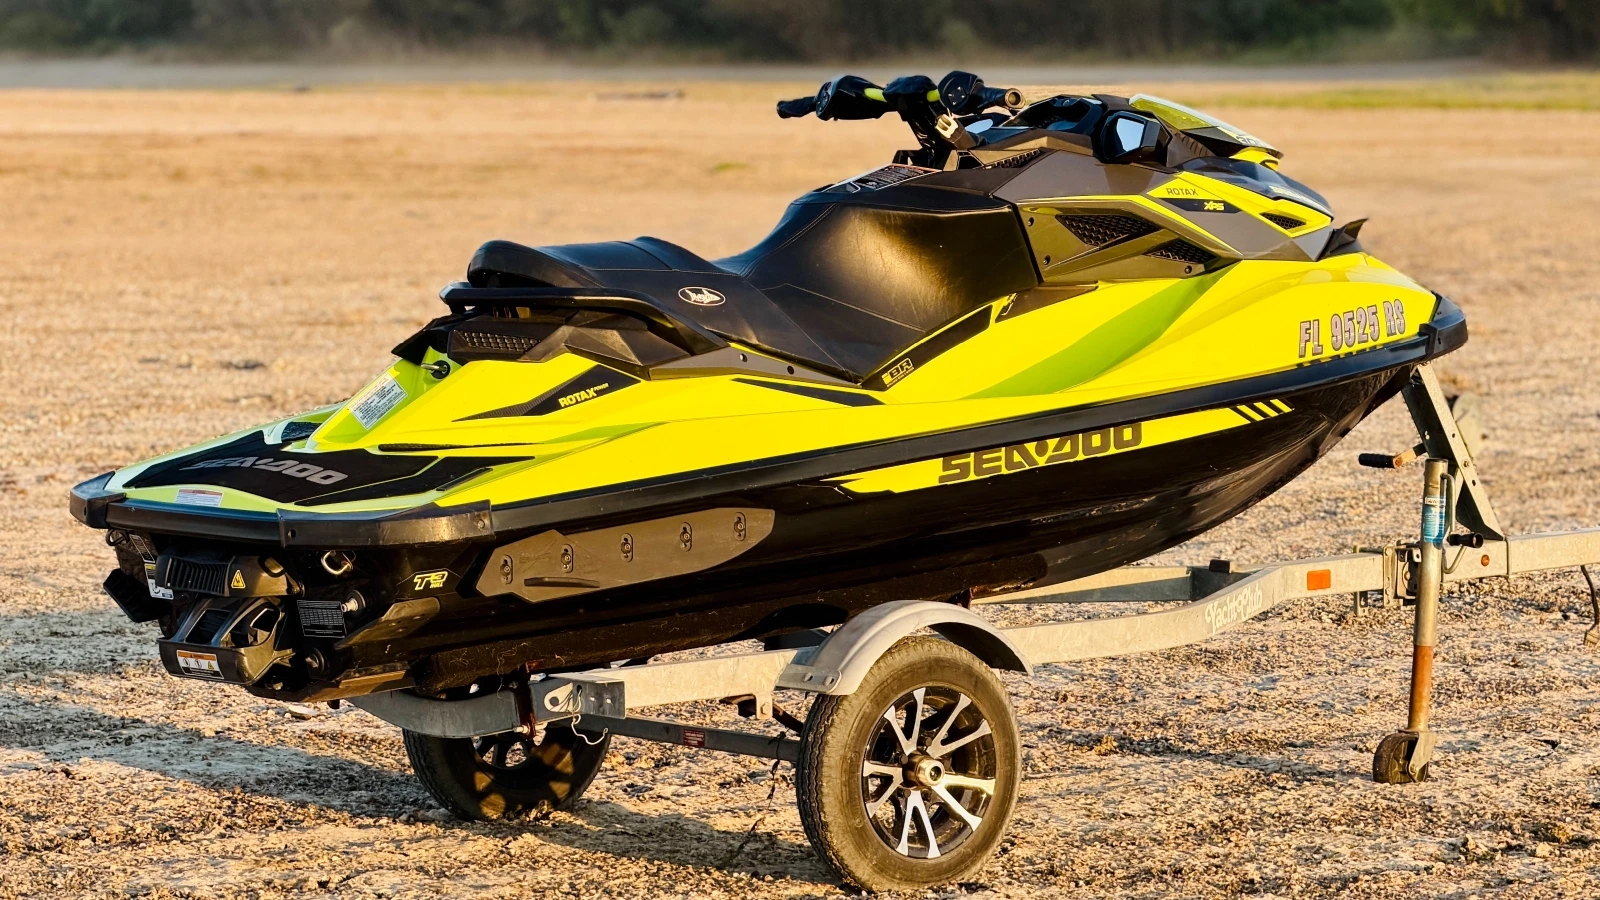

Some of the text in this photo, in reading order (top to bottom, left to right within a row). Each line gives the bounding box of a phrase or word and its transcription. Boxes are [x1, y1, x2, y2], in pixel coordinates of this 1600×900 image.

[1166, 187, 1198, 196] ROTAX
[1203, 201, 1225, 211] XPS
[1299, 298, 1406, 358] FL 9525 RS
[558, 387, 598, 408] ROTAX
